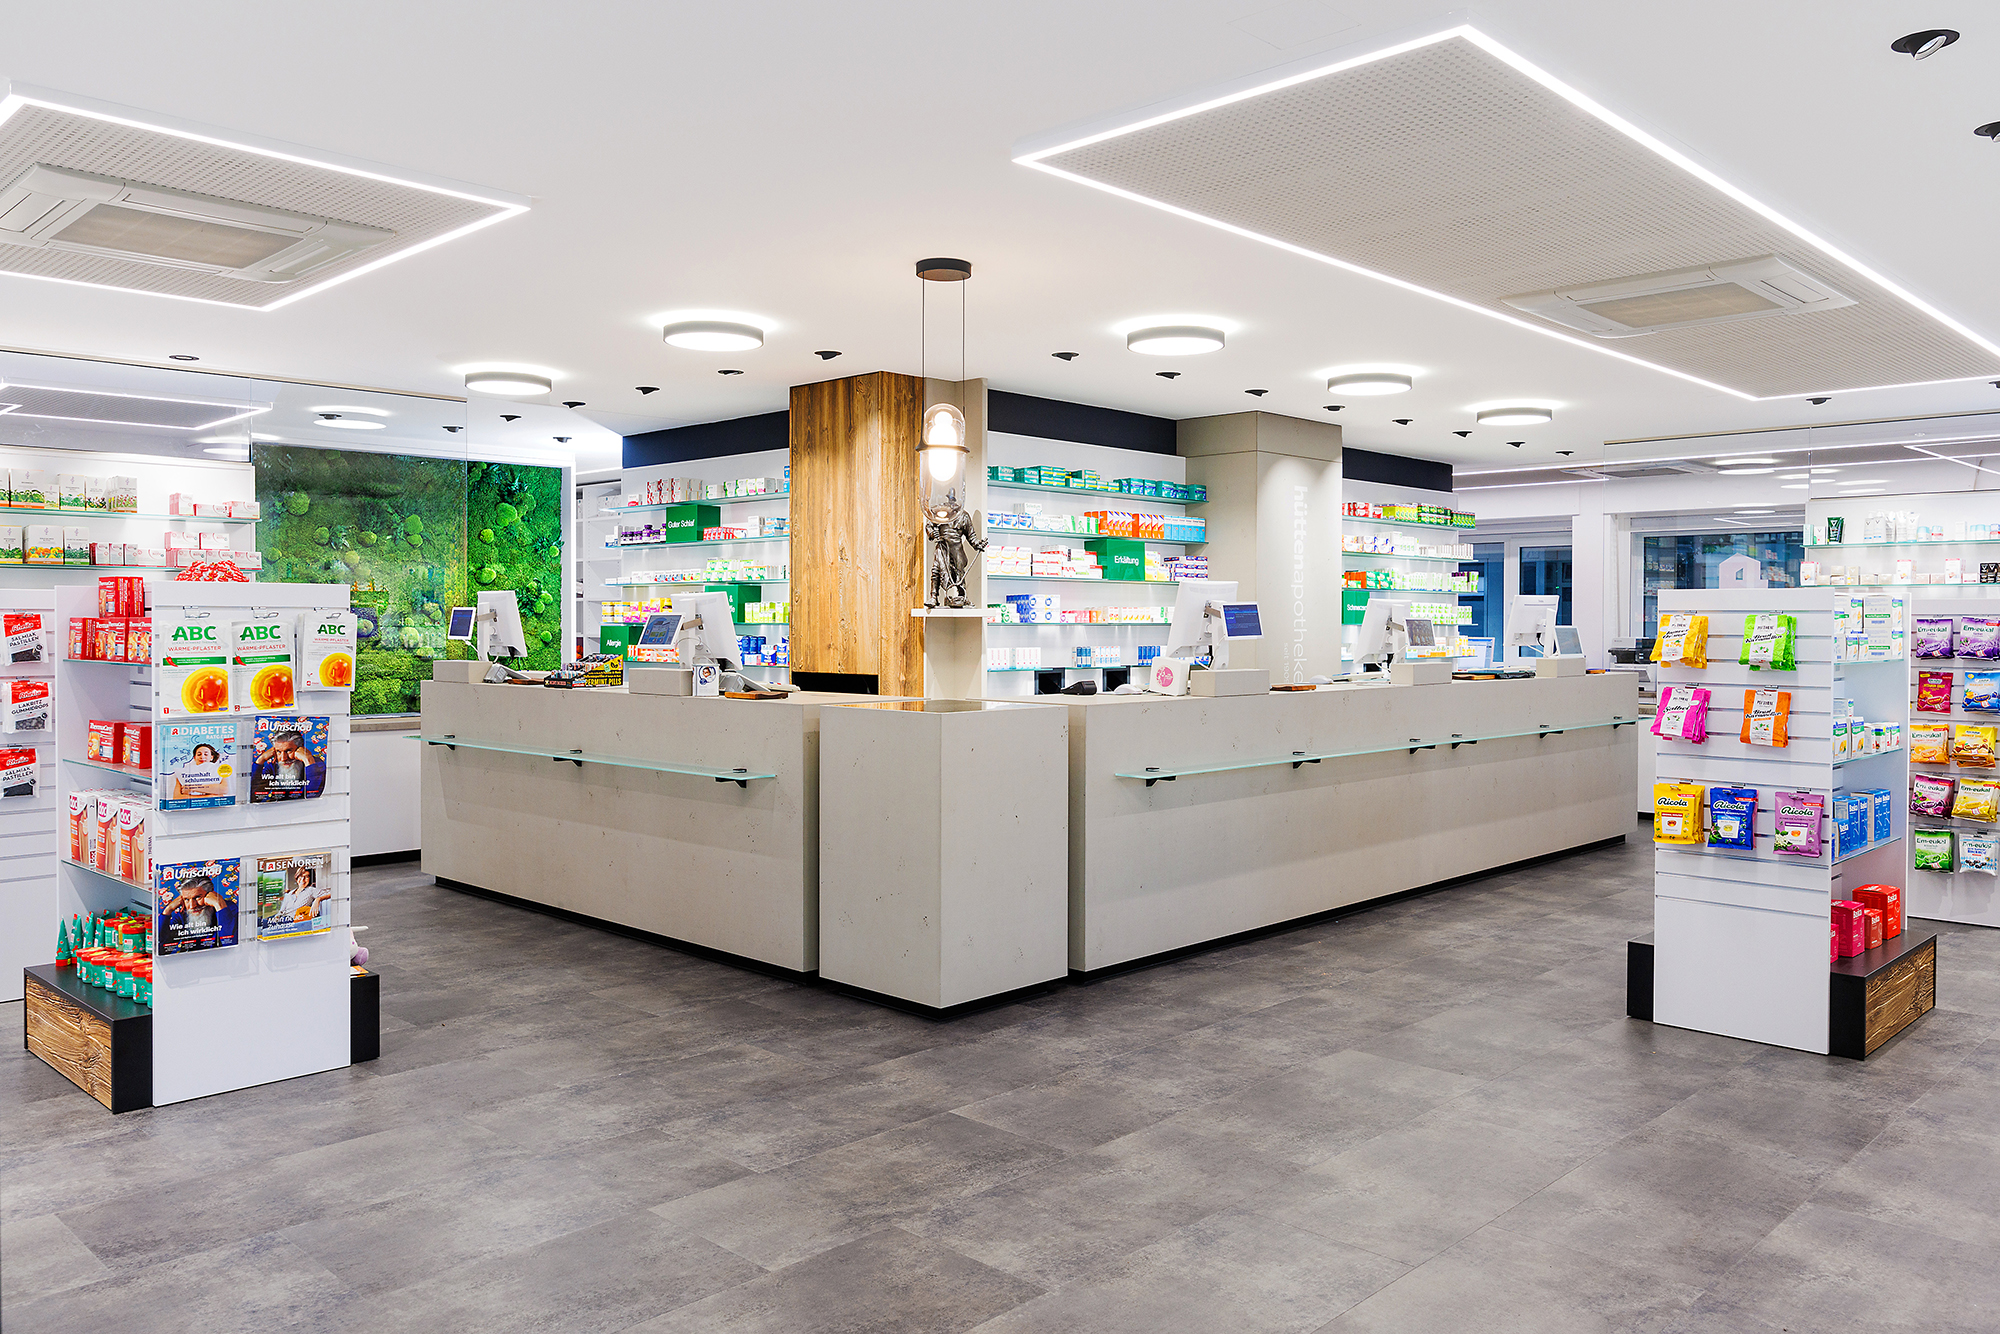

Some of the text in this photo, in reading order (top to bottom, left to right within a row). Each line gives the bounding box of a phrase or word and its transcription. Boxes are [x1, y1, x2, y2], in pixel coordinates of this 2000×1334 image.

[681, 519, 695, 527] Schlaf
[1114, 556, 1139, 566] Erkältung
[1291, 485, 1308, 683] hüttenapotheke
[171, 626, 217, 641] ABC
[240, 625, 281, 641] ABC
[317, 624, 346, 635] ABC
[10, 636, 39, 648] PASTILLEN
[11, 632, 37, 642] SALMIAK
[12, 703, 49, 714] GUMMIDROPS
[18, 700, 42, 708] LAKRITZ
[270, 721, 314, 732] Umschau
[2, 770, 34, 782] PASTILLEN
[5, 767, 31, 776] SALMIAK
[1658, 797, 1688, 807] Ricola
[1714, 800, 1746, 810] Ricola
[1781, 806, 1814, 816] Ricola
[276, 858, 324, 869] SENIOREN
[174, 864, 222, 879] Umschau
[190, 925, 222, 934] wirklich?
